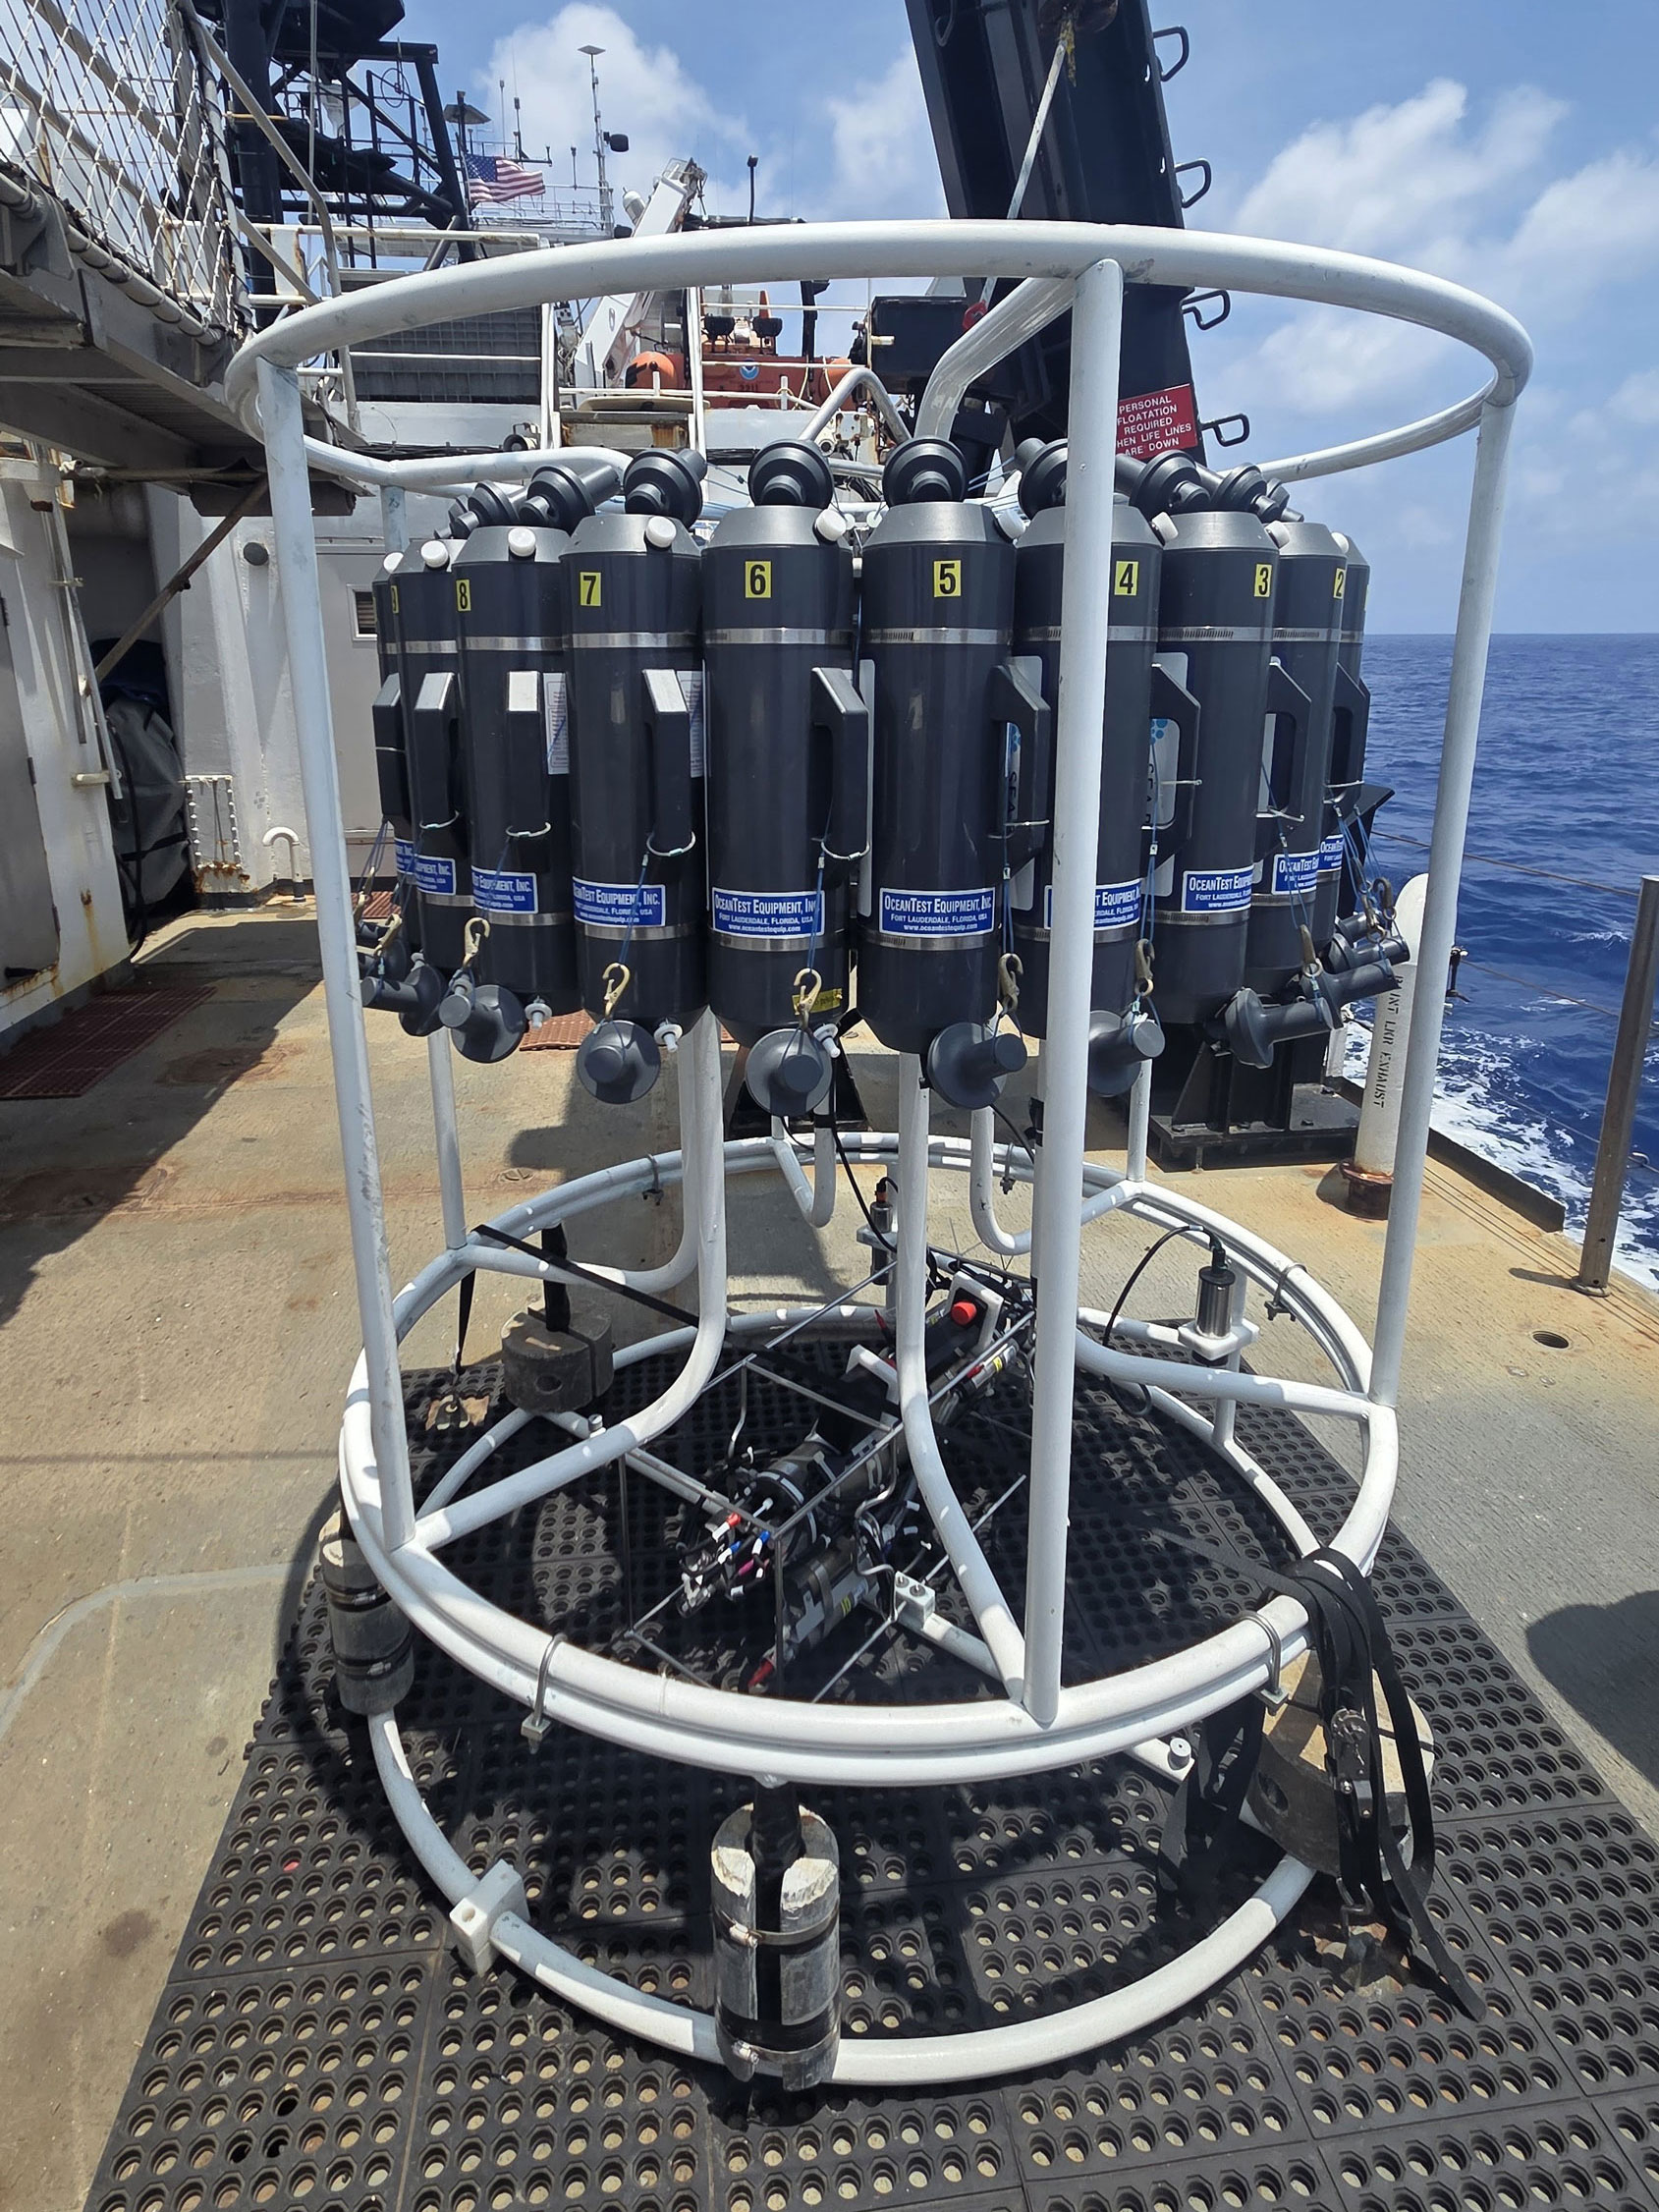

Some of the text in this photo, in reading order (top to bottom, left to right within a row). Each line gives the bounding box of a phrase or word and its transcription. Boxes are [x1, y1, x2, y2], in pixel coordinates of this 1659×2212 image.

[1117, 405, 1178, 425] FLOATATION
[1119, 395, 1172, 415] PERSONAL
[1117, 422, 1191, 448] HEN LIFE LINES
[1124, 416, 1173, 435] REQUIRED
[1125, 437, 1179, 456] ARE DOWN
[582, 575, 597, 605] 7
[749, 564, 766, 595] 6
[939, 563, 956, 594] 5
[1119, 563, 1134, 594] 4
[1258, 567, 1269, 595] 3
[1336, 571, 1344, 597] 2
[459, 581, 468, 609] 8
[1373, 1051, 1392, 1109] EXHAUST
